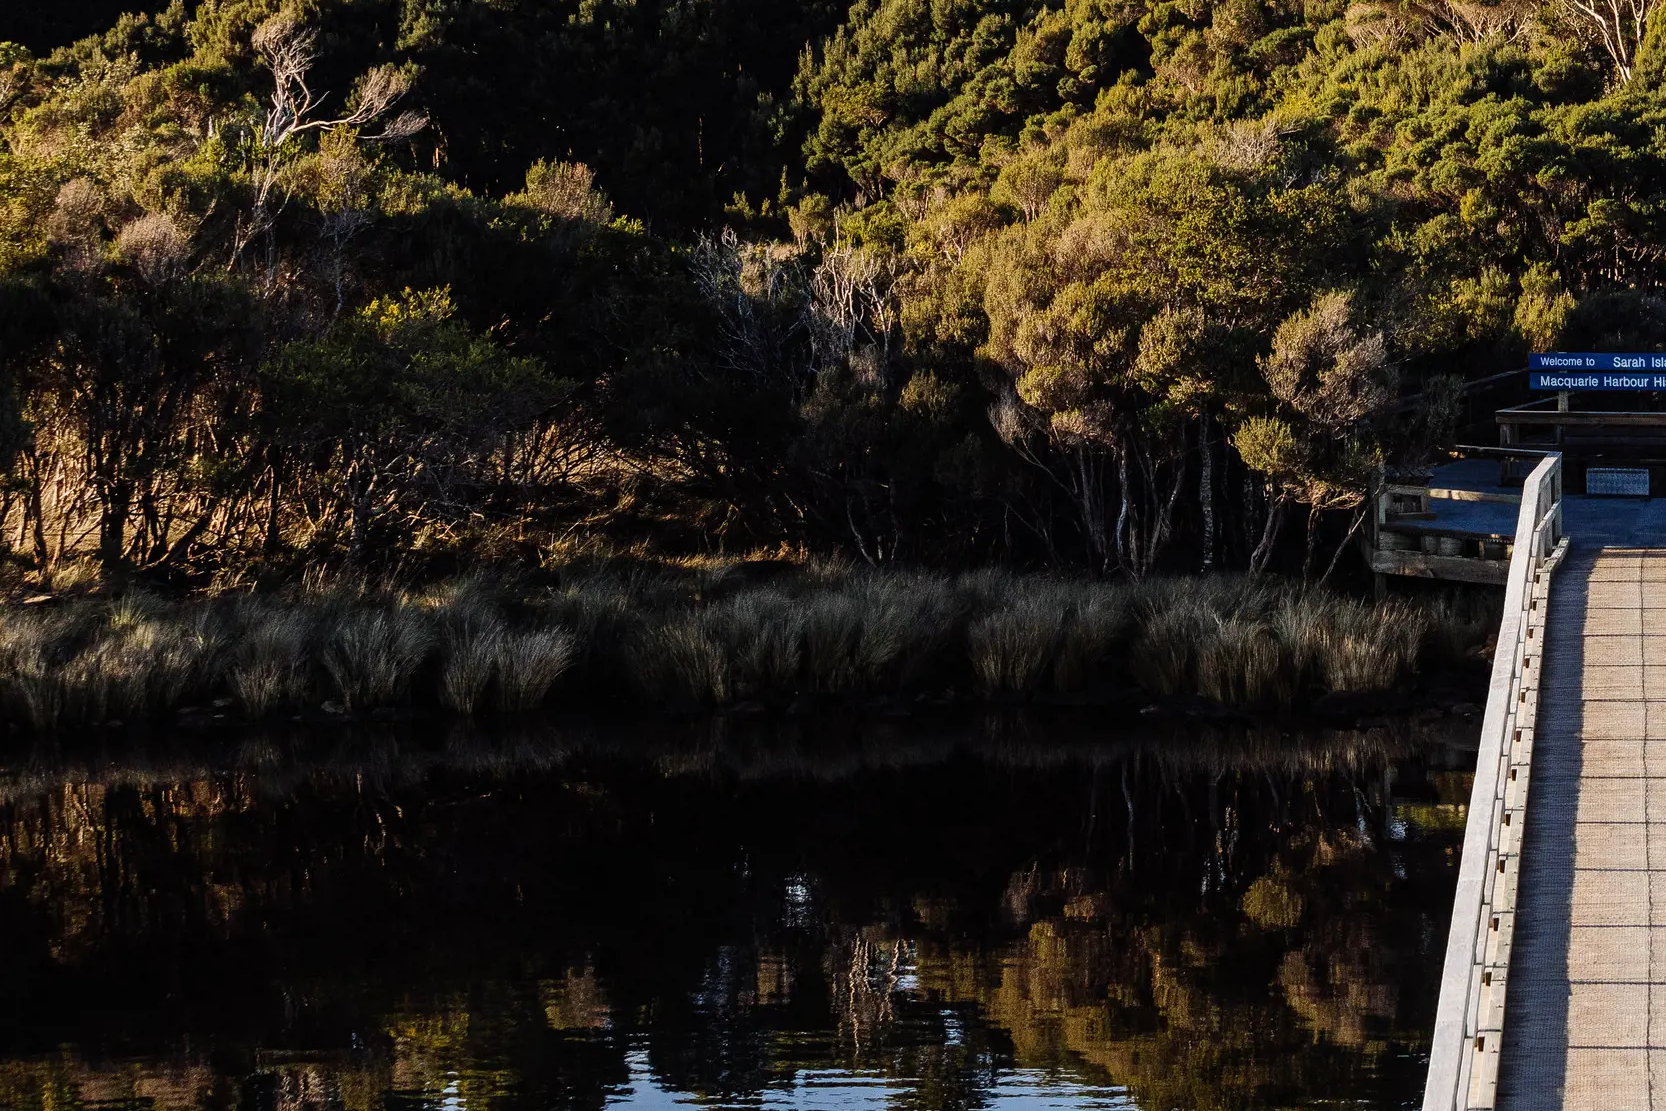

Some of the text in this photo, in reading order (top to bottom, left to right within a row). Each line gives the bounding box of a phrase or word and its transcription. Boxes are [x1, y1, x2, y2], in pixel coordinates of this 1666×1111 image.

[1540, 356, 1583, 367] Welcome
[1586, 357, 1595, 367] to
[1613, 356, 1646, 368] Sarah
[1540, 376, 1598, 388] Macquarie
[1604, 376, 1649, 388] Harbour
